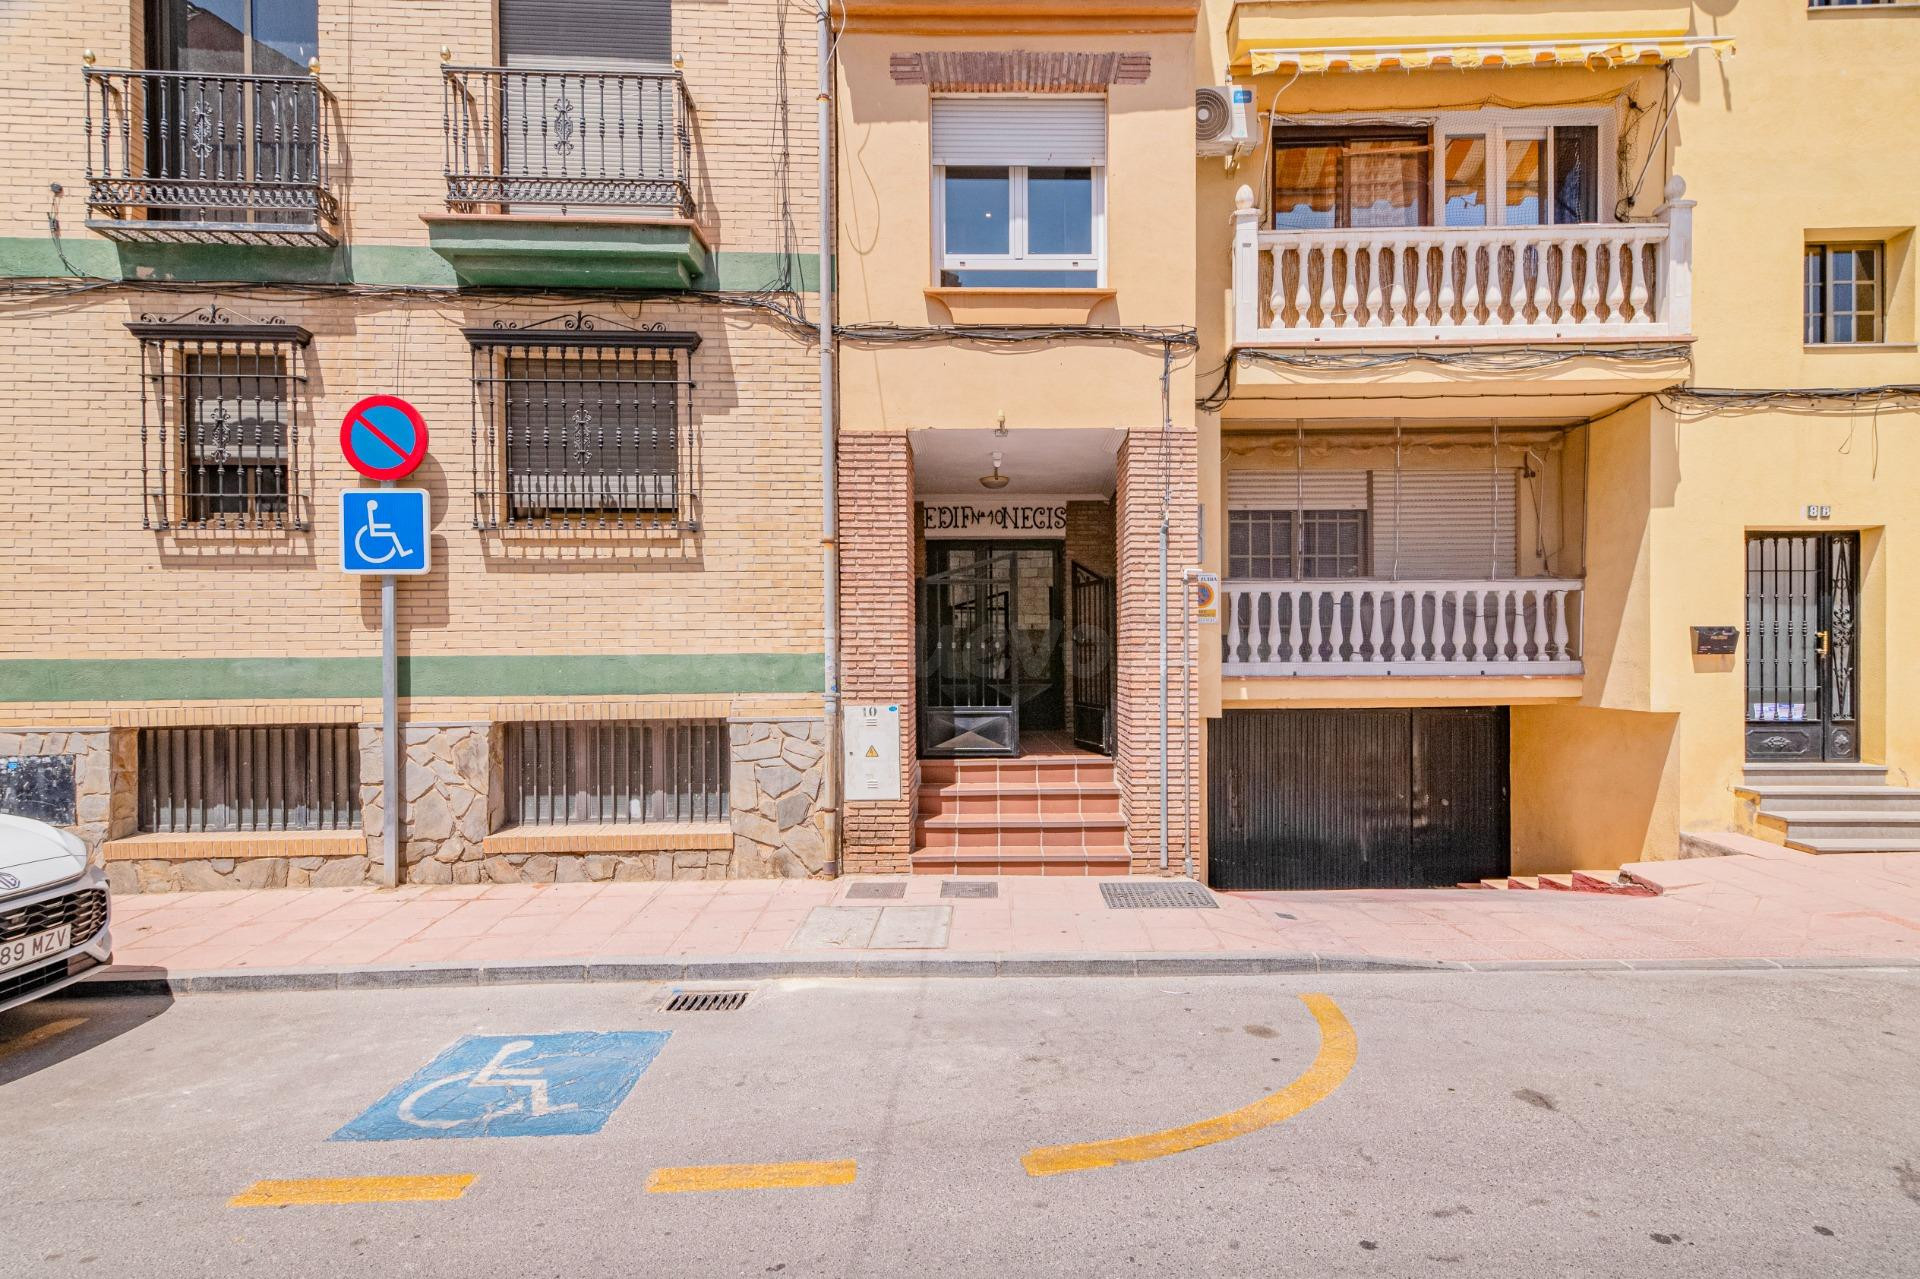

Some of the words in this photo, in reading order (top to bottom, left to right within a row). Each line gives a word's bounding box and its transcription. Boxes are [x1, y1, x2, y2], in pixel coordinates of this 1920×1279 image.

[924, 505, 973, 529] EDIF
[987, 509, 1004, 525] 10
[863, 706, 877, 717] 10
[32, 928, 67, 956] MZV
